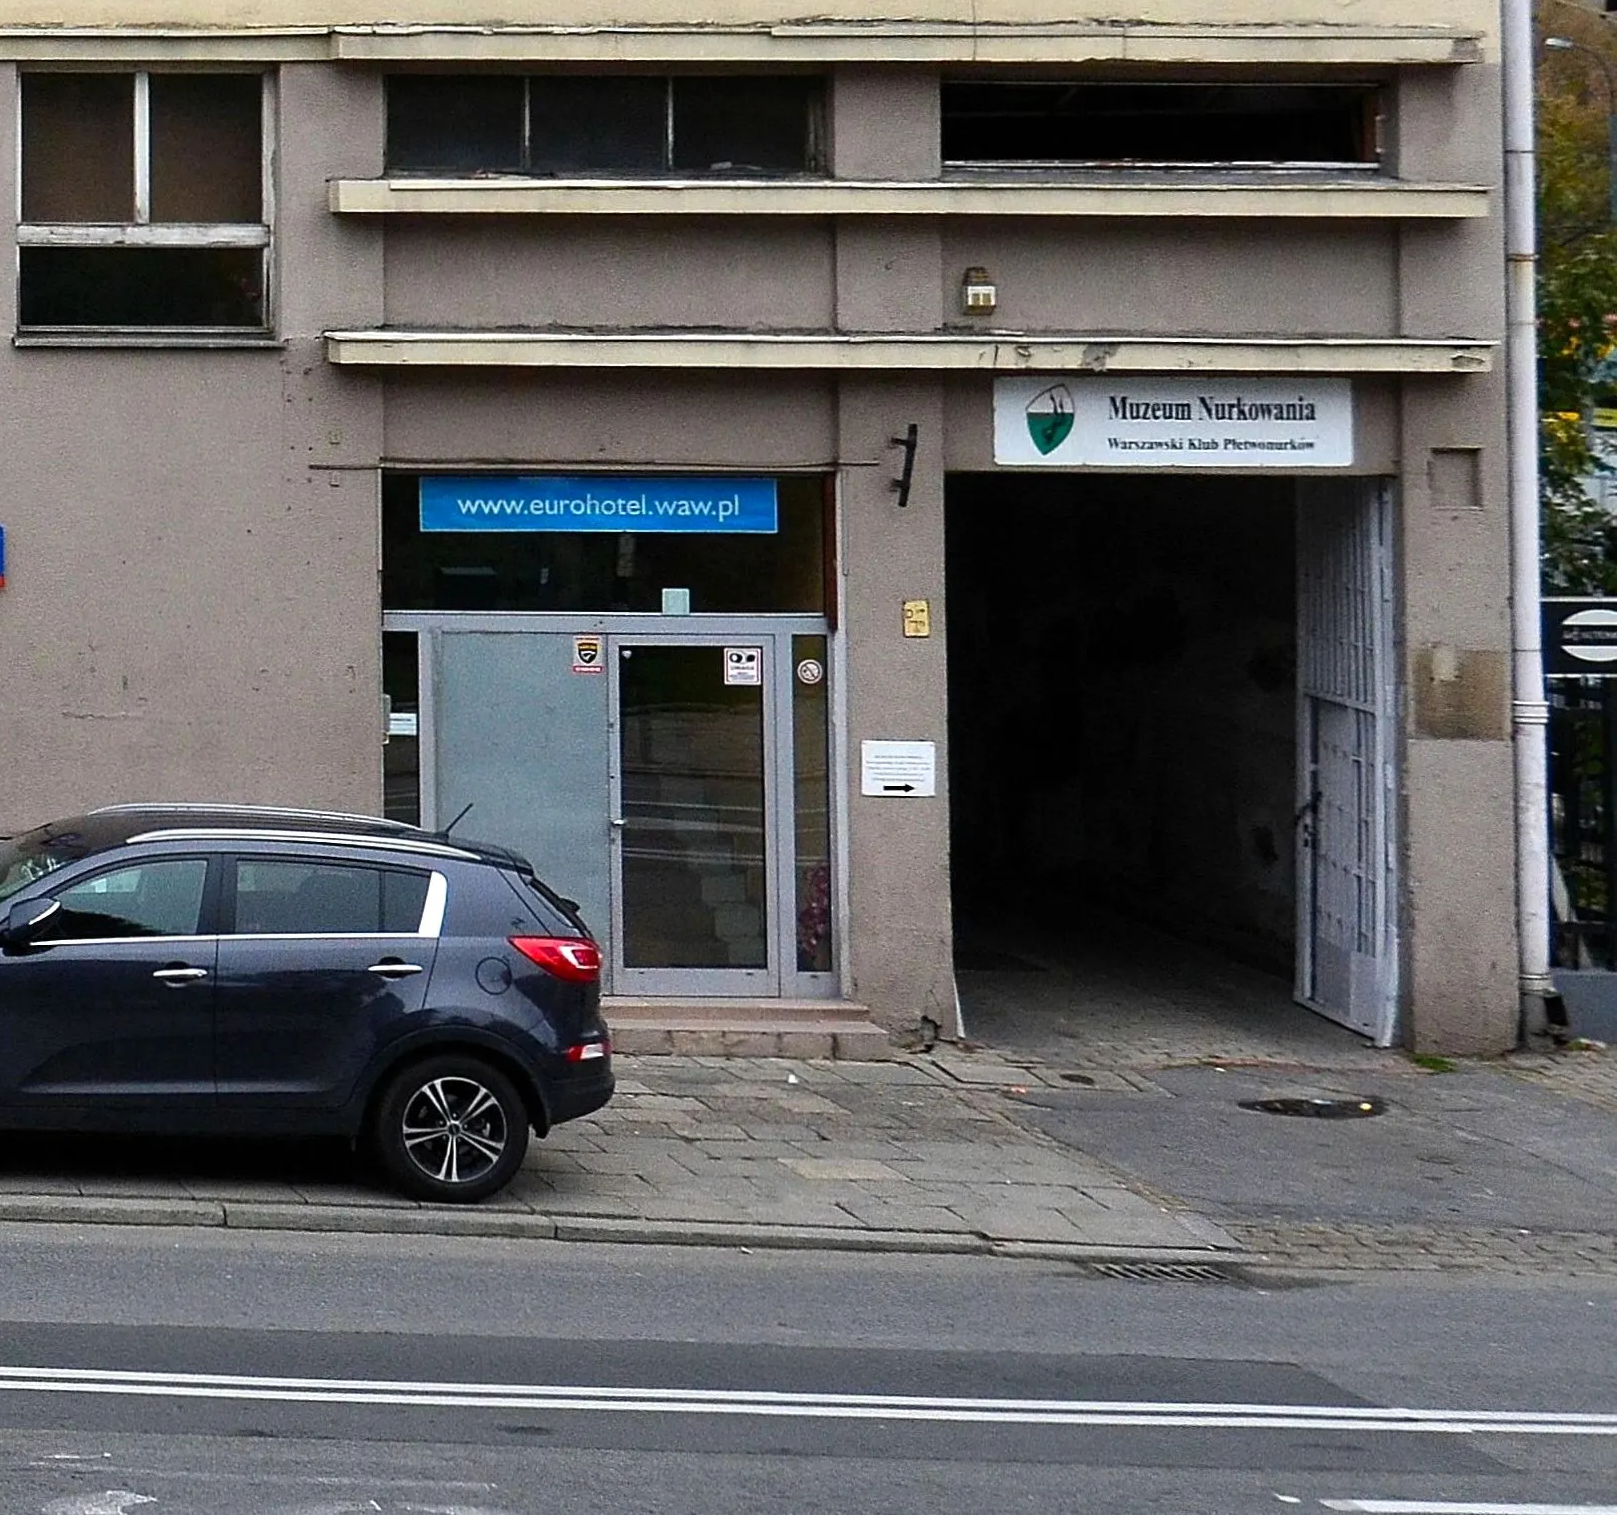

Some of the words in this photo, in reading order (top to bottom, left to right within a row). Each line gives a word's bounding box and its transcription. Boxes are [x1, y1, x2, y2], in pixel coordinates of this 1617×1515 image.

[1109, 396, 1192, 421] Muzeum
[1198, 395, 1317, 421] Nurkowania
[1107, 437, 1184, 451] Warszawski
[1188, 437, 1219, 451] Klub
[457, 494, 740, 523] www.eurohotel.waw.pl
